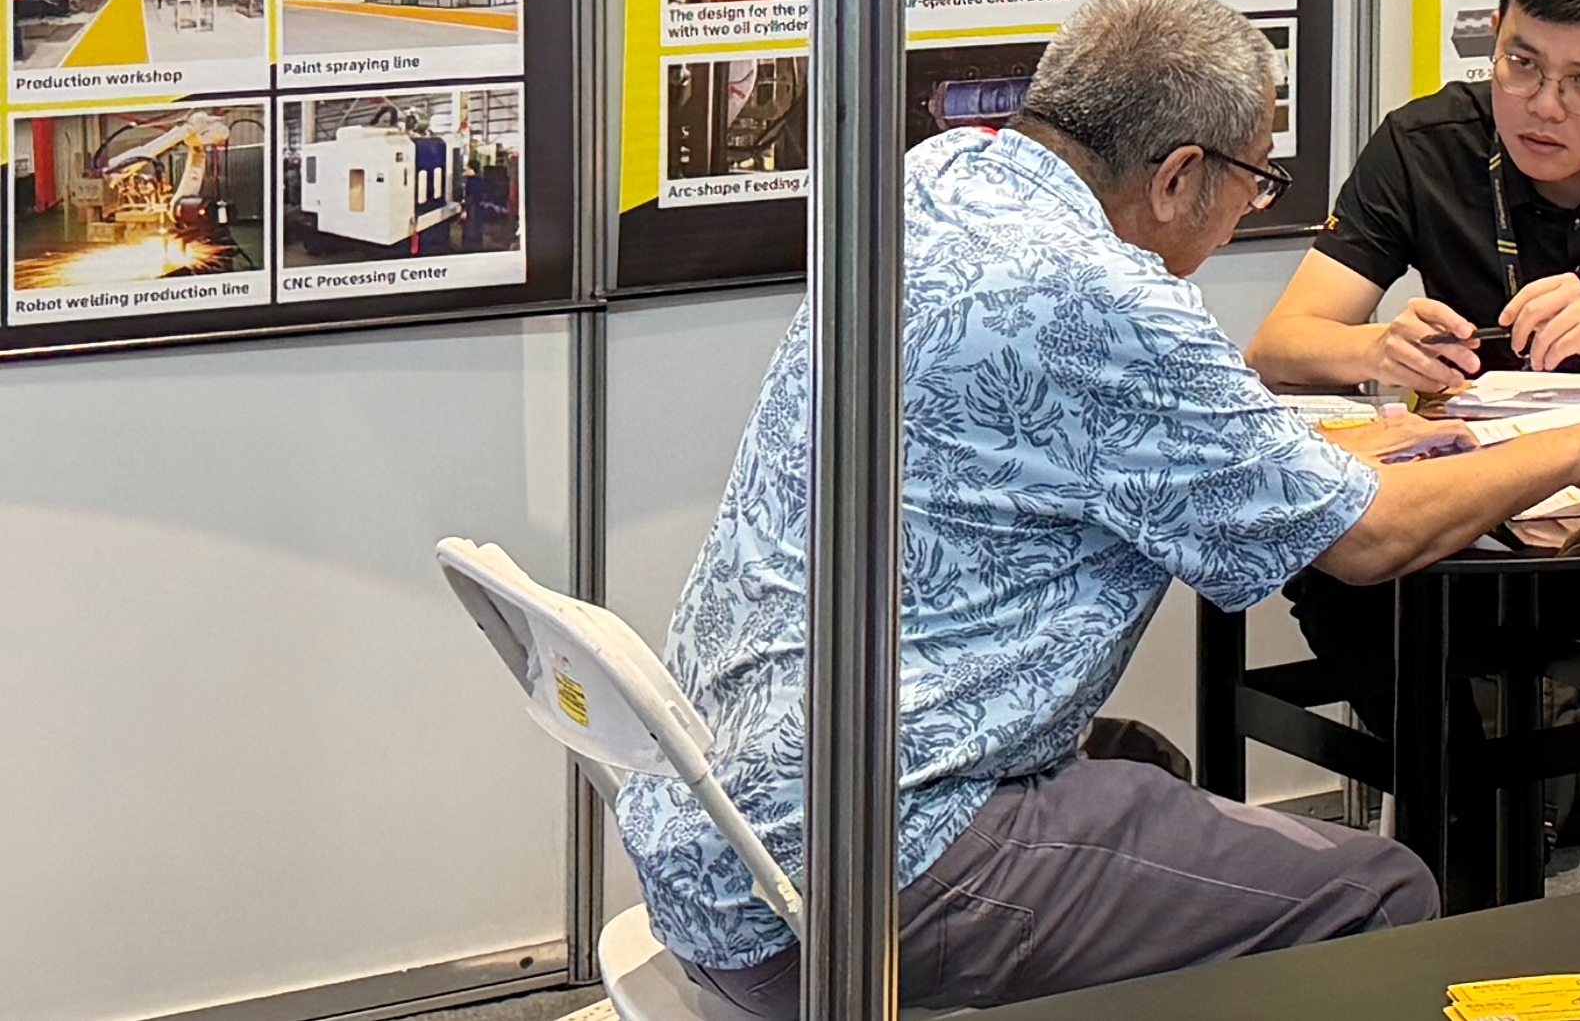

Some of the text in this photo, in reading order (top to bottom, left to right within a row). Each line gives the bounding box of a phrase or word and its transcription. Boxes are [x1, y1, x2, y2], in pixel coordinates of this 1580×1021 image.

[668, 8, 695, 22] The
[697, 5, 746, 22] design
[749, 4, 769, 18] for
[772, 3, 796, 17] the
[668, 24, 699, 39] with
[703, 23, 731, 37] two
[733, 21, 751, 34] oil
[283, 54, 421, 75] Paint spraying line
[16, 68, 183, 90] Production workshop
[667, 177, 801, 199] Arc-shape Feeding
[283, 264, 447, 291] CNC Processing Center
[15, 281, 250, 314] Robot welding production line
